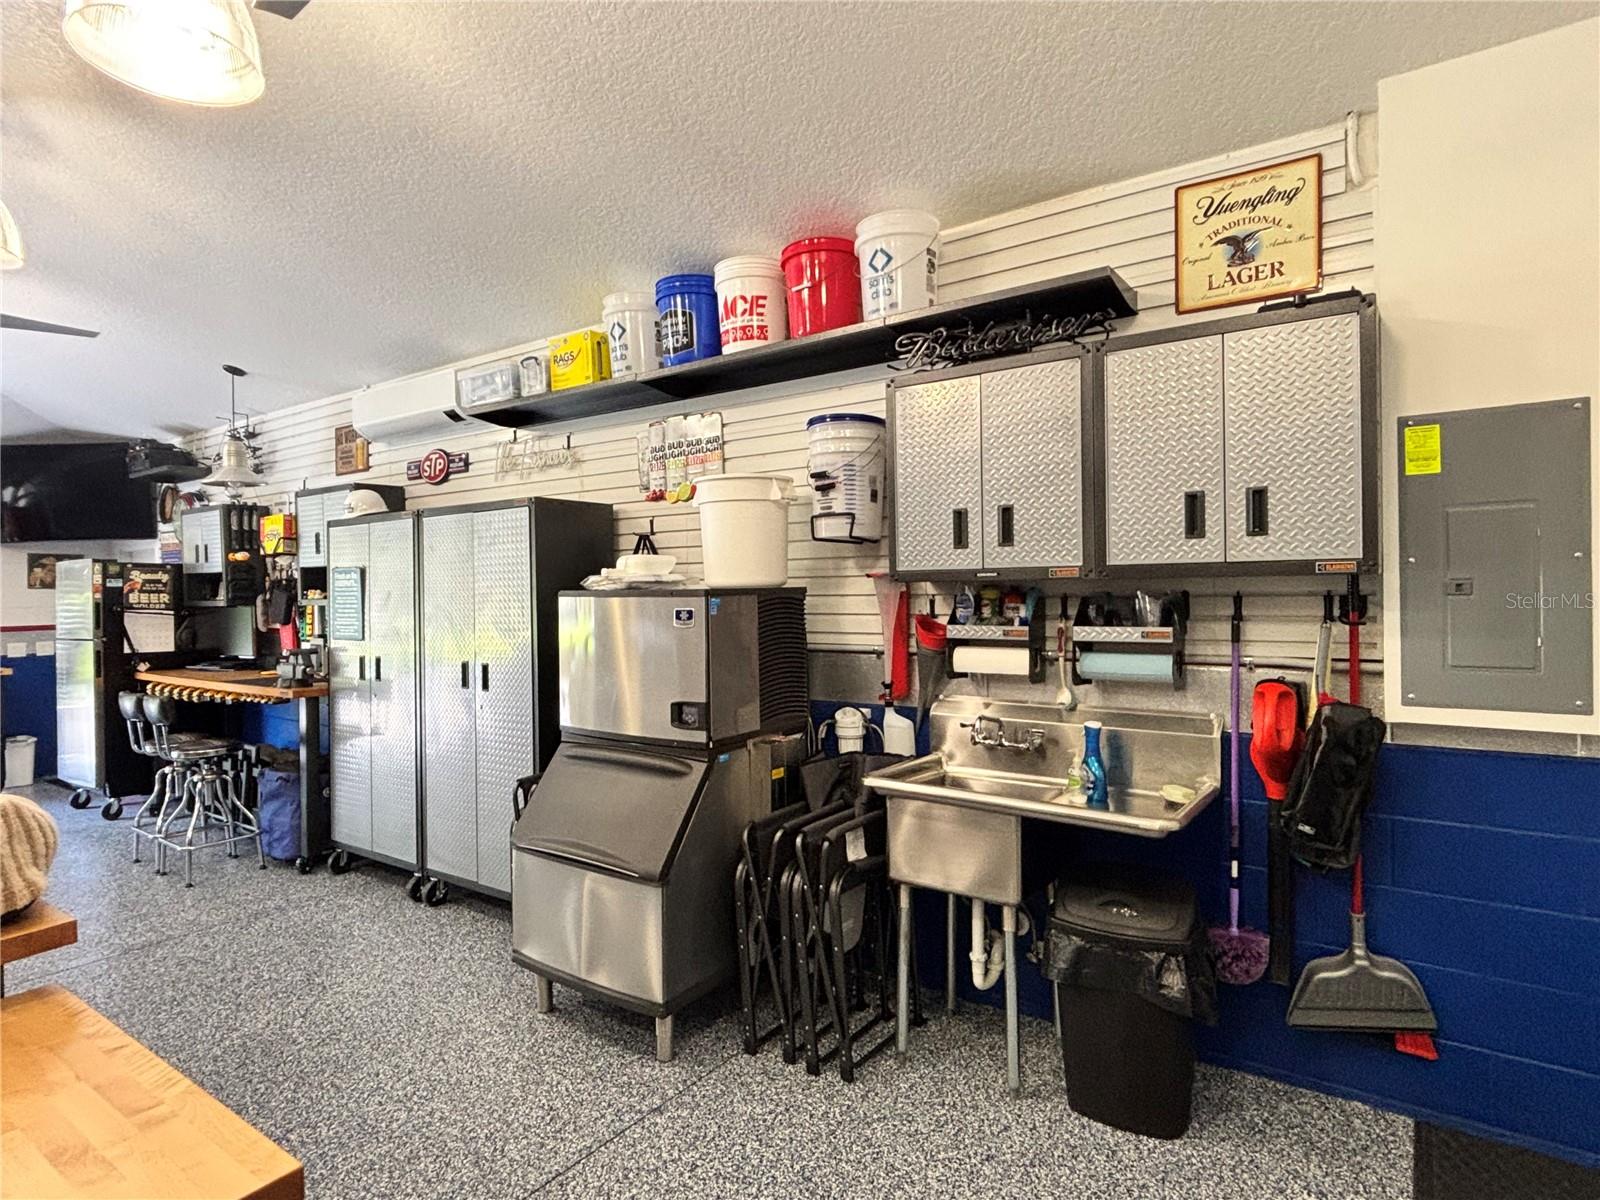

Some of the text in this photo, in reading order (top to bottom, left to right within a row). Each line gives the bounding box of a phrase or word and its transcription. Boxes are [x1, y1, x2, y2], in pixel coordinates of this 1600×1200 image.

[1192, 176, 1306, 226] Yuengling
[1206, 215, 1283, 242] TRADITIONAL
[1207, 260, 1286, 291] LAGER
[871, 288, 892, 300] clb
[721, 294, 769, 324] ACE
[895, 309, 1117, 369] Budweiser
[553, 350, 575, 366] RAGS
[667, 440, 684, 451] BUD
[423, 453, 445, 477] STP
[128, 590, 170, 604] BEER
